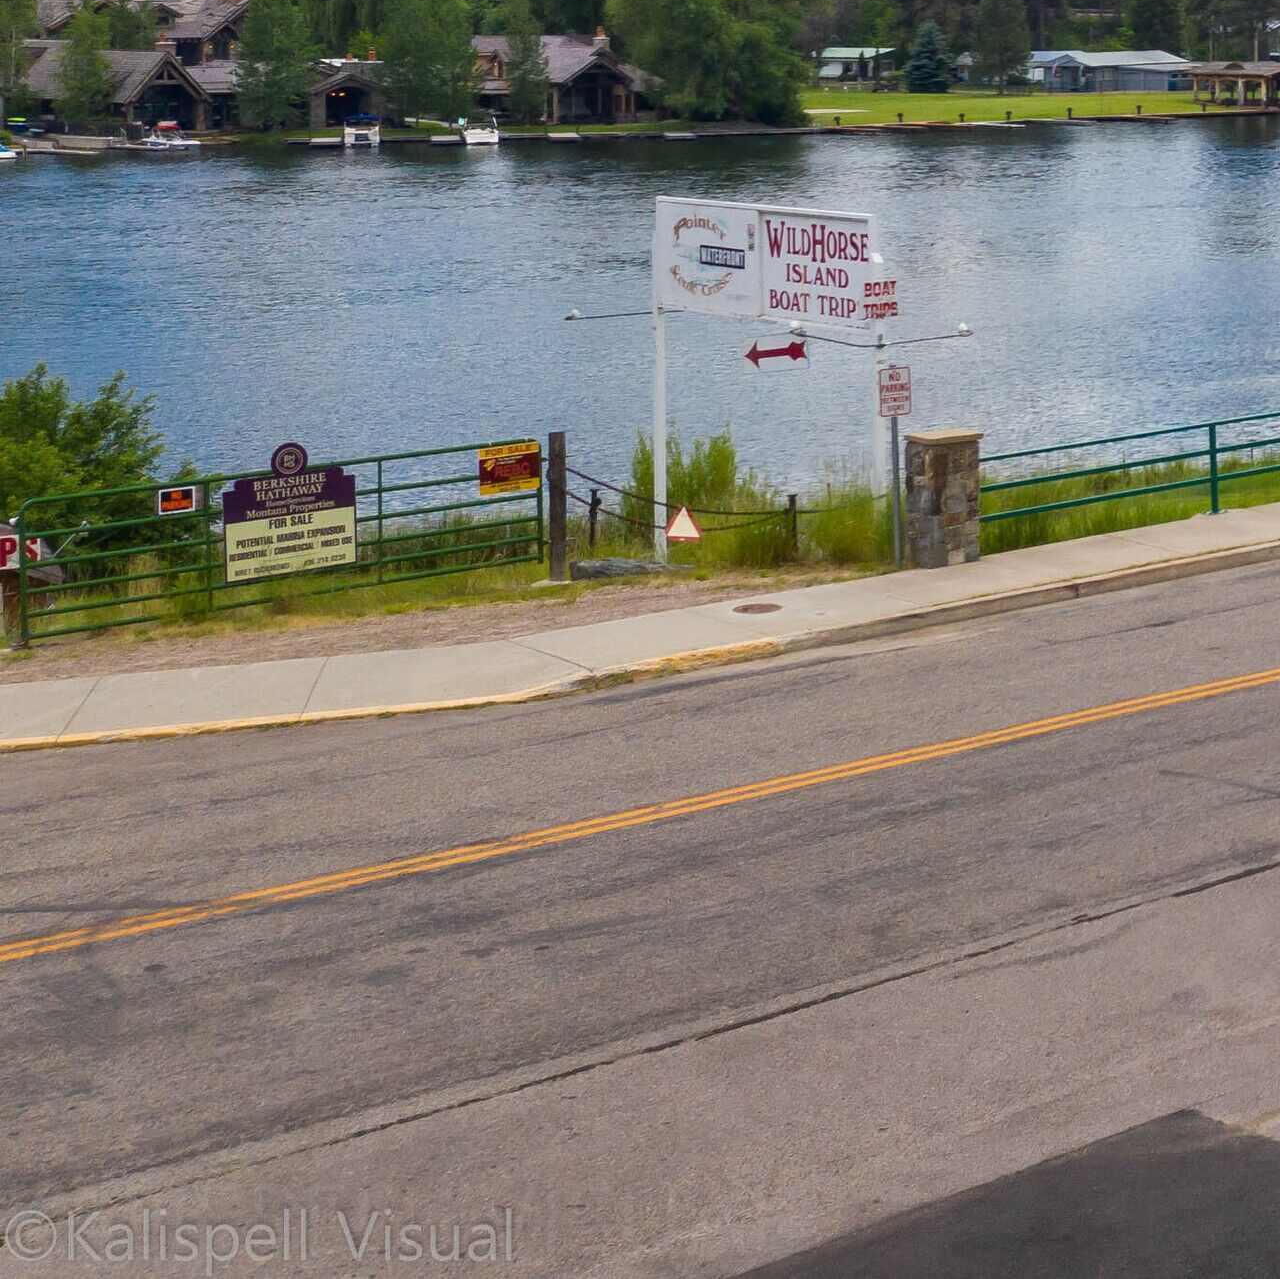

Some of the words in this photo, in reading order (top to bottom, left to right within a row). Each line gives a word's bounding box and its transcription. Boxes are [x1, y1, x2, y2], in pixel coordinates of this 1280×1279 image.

[701, 247, 744, 268] WATERFRONT
[786, 264, 849, 288] ISLAND
[864, 281, 896, 297] BOAT
[769, 289, 811, 312] BOAT
[863, 302, 898, 319] TRIPS
[889, 372, 900, 381] NO
[881, 383, 909, 392] PARKING
[485, 448, 503, 456] FOR
[508, 444, 532, 453] SALE
[254, 472, 327, 491] BERKSHIRE
[256, 483, 324, 501] HATHAWAY
[246, 507, 287, 519] Montana
[289, 499, 336, 514] Properties
[268, 519, 287, 530] FOR
[290, 513, 314, 525] SALE
[236, 535, 274, 549] POTENTIAL
[276, 530, 305, 542] MARINA
[307, 524, 346, 539] EXPANSION
[229, 549, 267, 561] RESIDENTIAL
[274, 542, 315, 555] COMMERCIAL
[341, 535, 353, 544] USE
